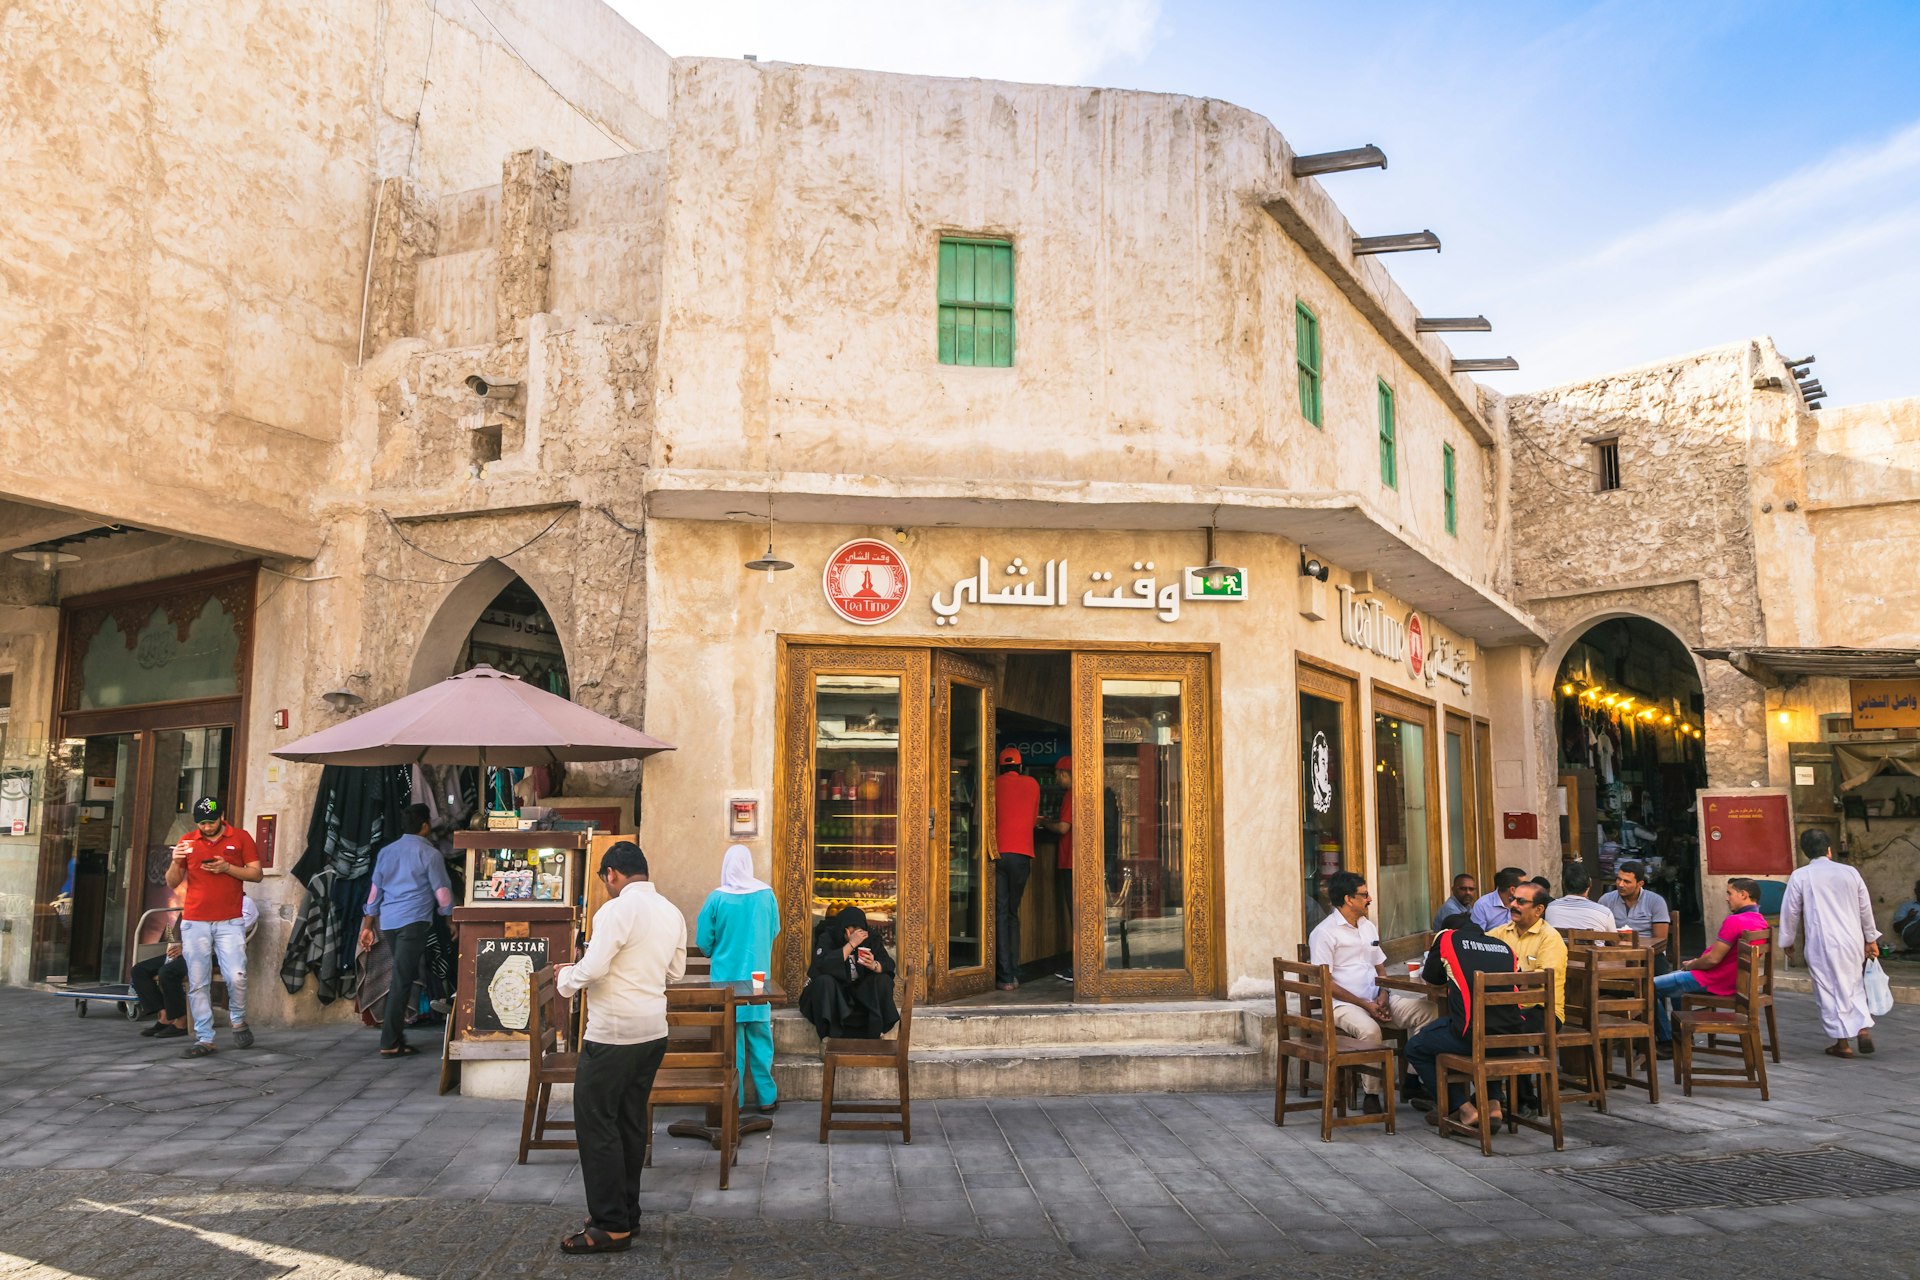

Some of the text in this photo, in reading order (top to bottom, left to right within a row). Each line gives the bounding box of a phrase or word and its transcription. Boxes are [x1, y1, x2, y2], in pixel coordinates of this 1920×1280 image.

[845, 551, 890, 563] وقت الشاي
[931, 555, 1180, 626] وقت الشاي
[843, 599, 890, 612] Tea Time
[500, 942, 545, 952] WESTAR
